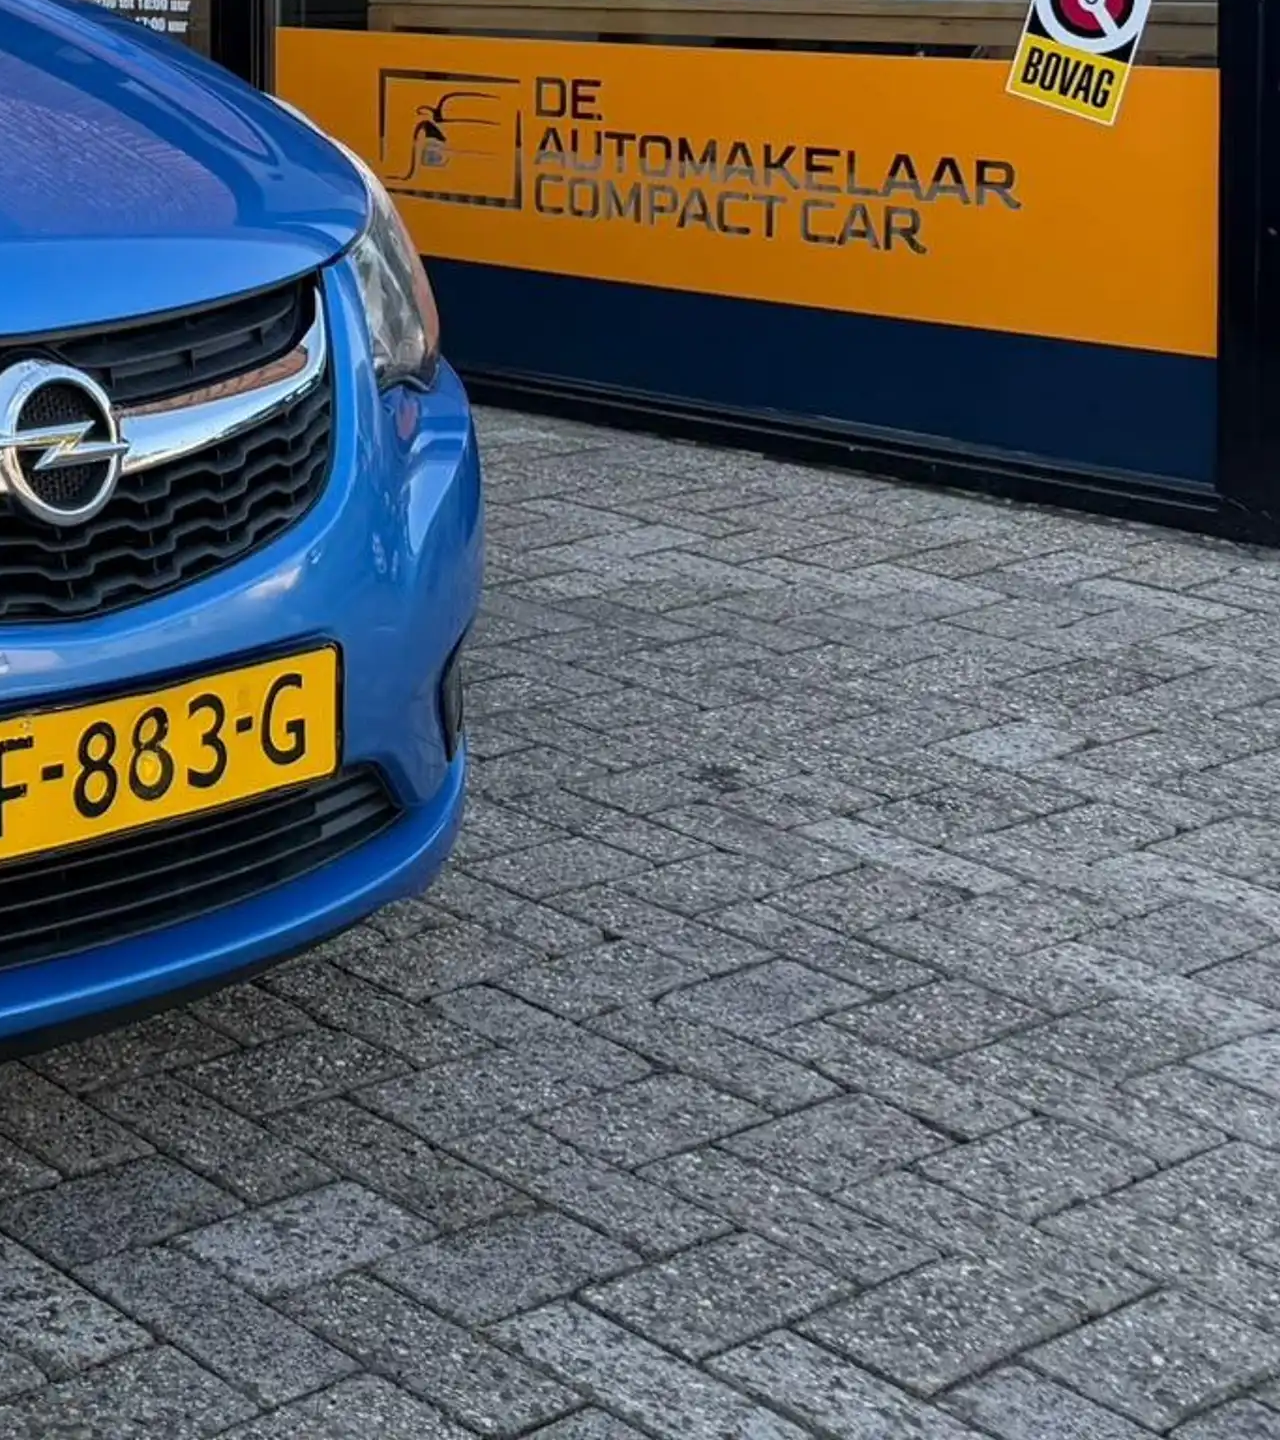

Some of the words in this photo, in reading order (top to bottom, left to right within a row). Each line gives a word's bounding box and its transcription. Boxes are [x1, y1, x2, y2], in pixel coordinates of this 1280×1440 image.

[168, 20, 189, 33] uur
[170, 0, 191, 12] uur
[1021, 46, 1116, 109] BOVAG
[534, 127, 1023, 210] AUTOMAKELAAR
[534, 173, 786, 239] COMPACT
[800, 199, 928, 254] CAR
